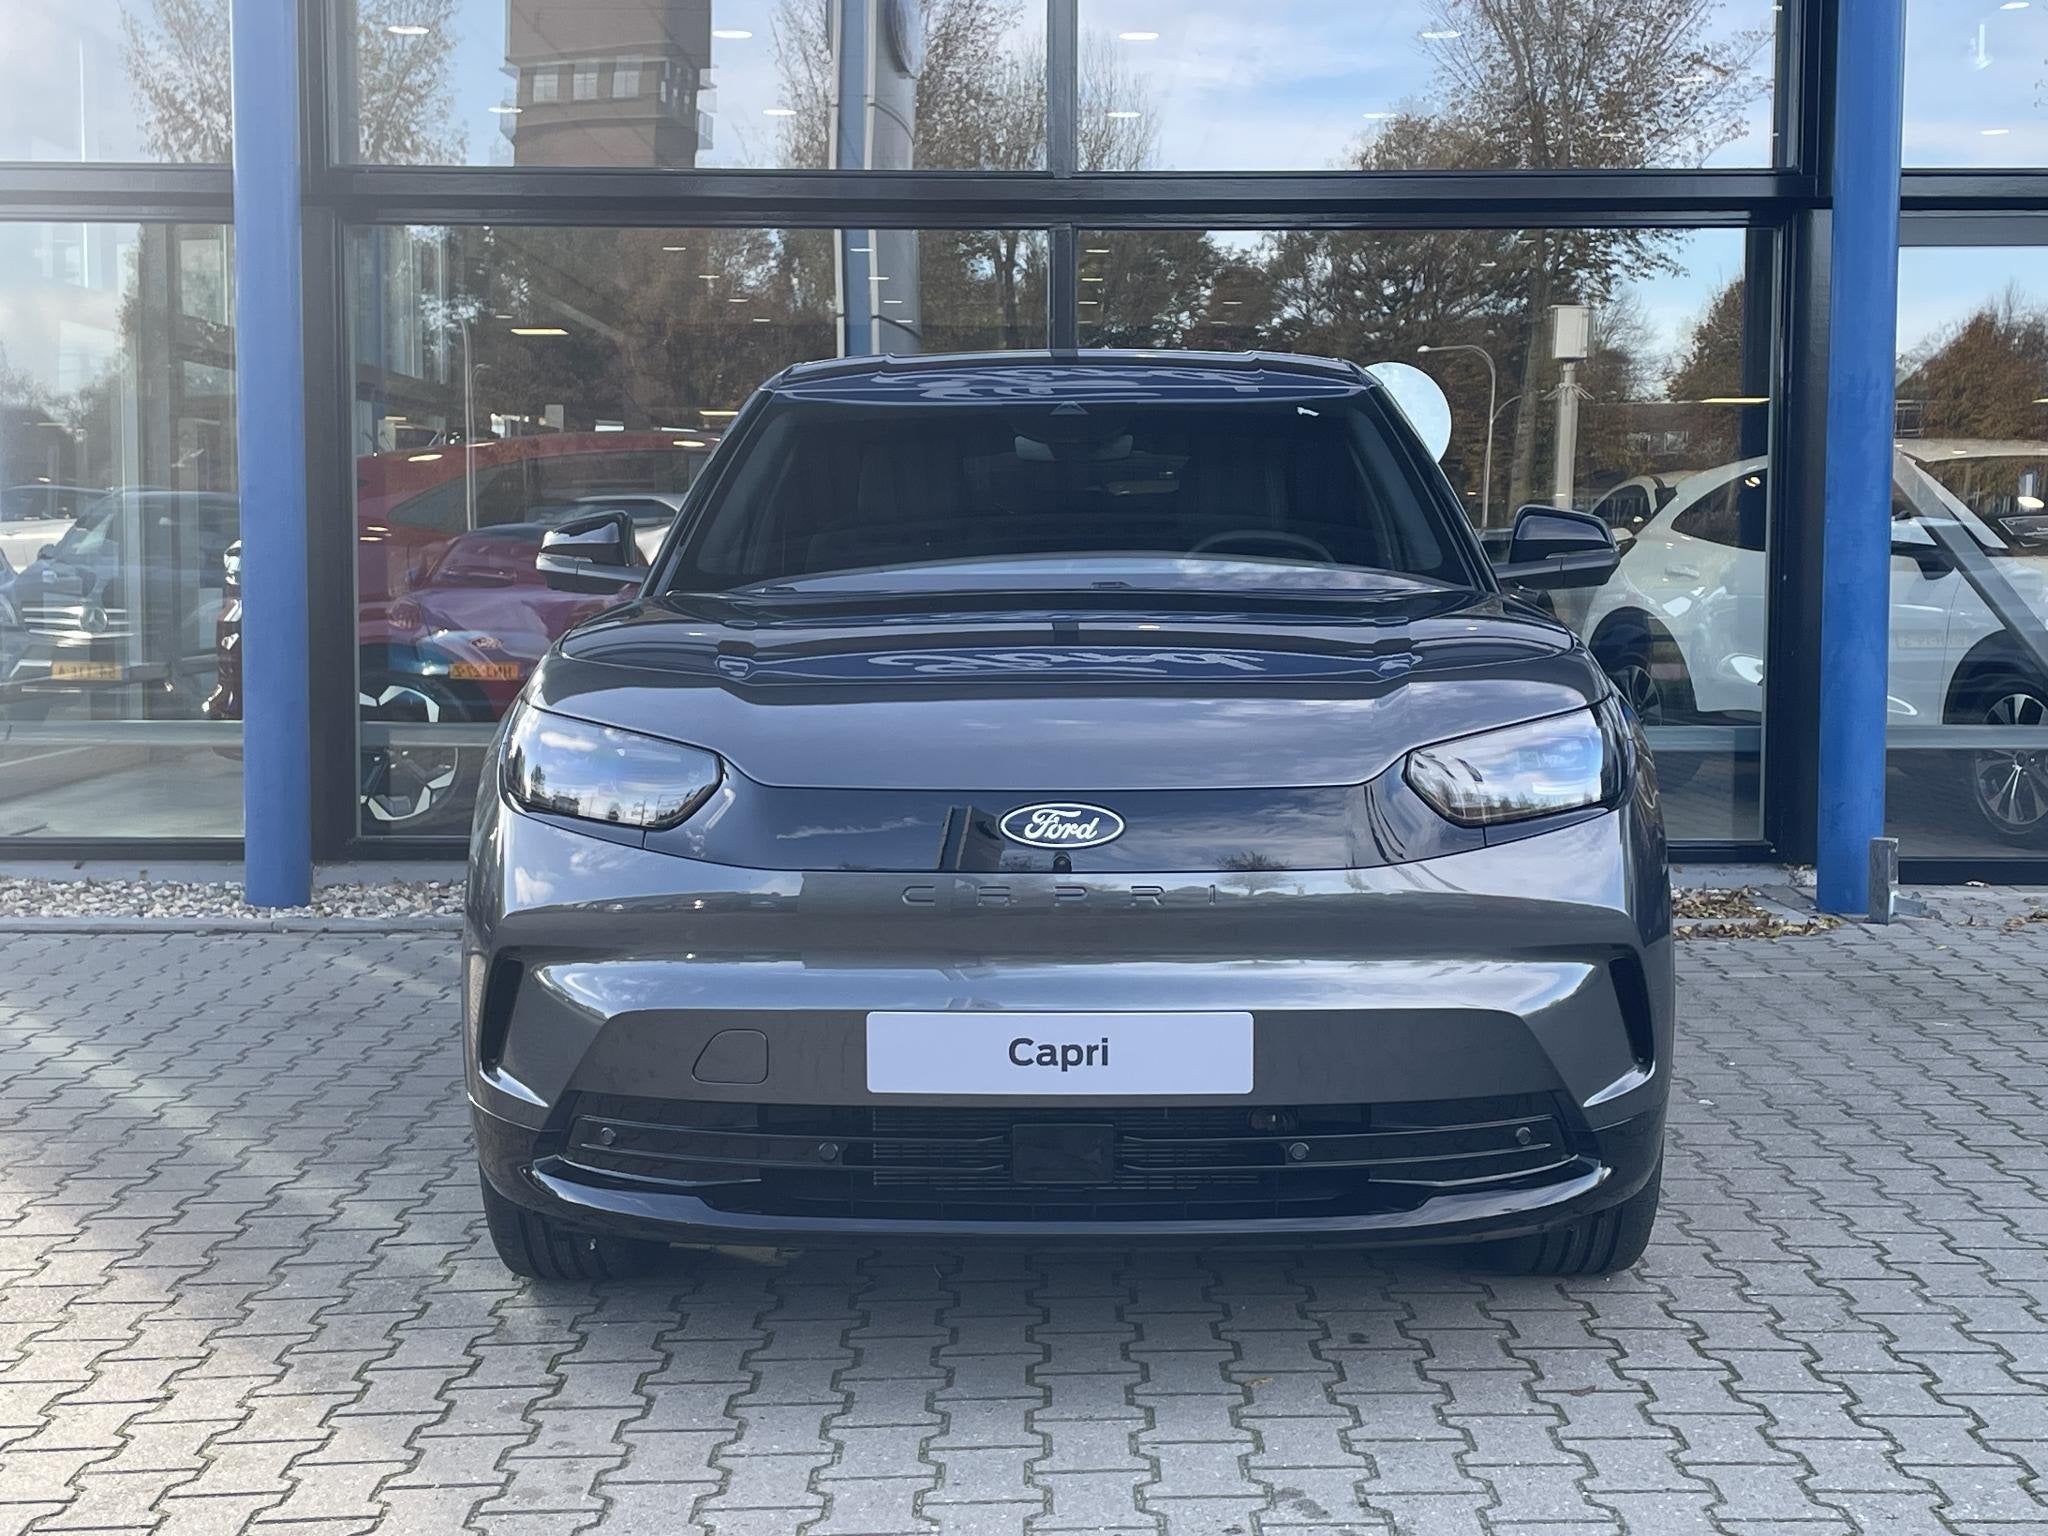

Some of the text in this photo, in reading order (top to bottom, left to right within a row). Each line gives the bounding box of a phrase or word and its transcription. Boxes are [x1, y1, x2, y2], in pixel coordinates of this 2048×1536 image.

[1024, 808, 1101, 841] Ford
[901, 884, 1216, 907] CAPRI
[1008, 1037, 1109, 1072] Capri
